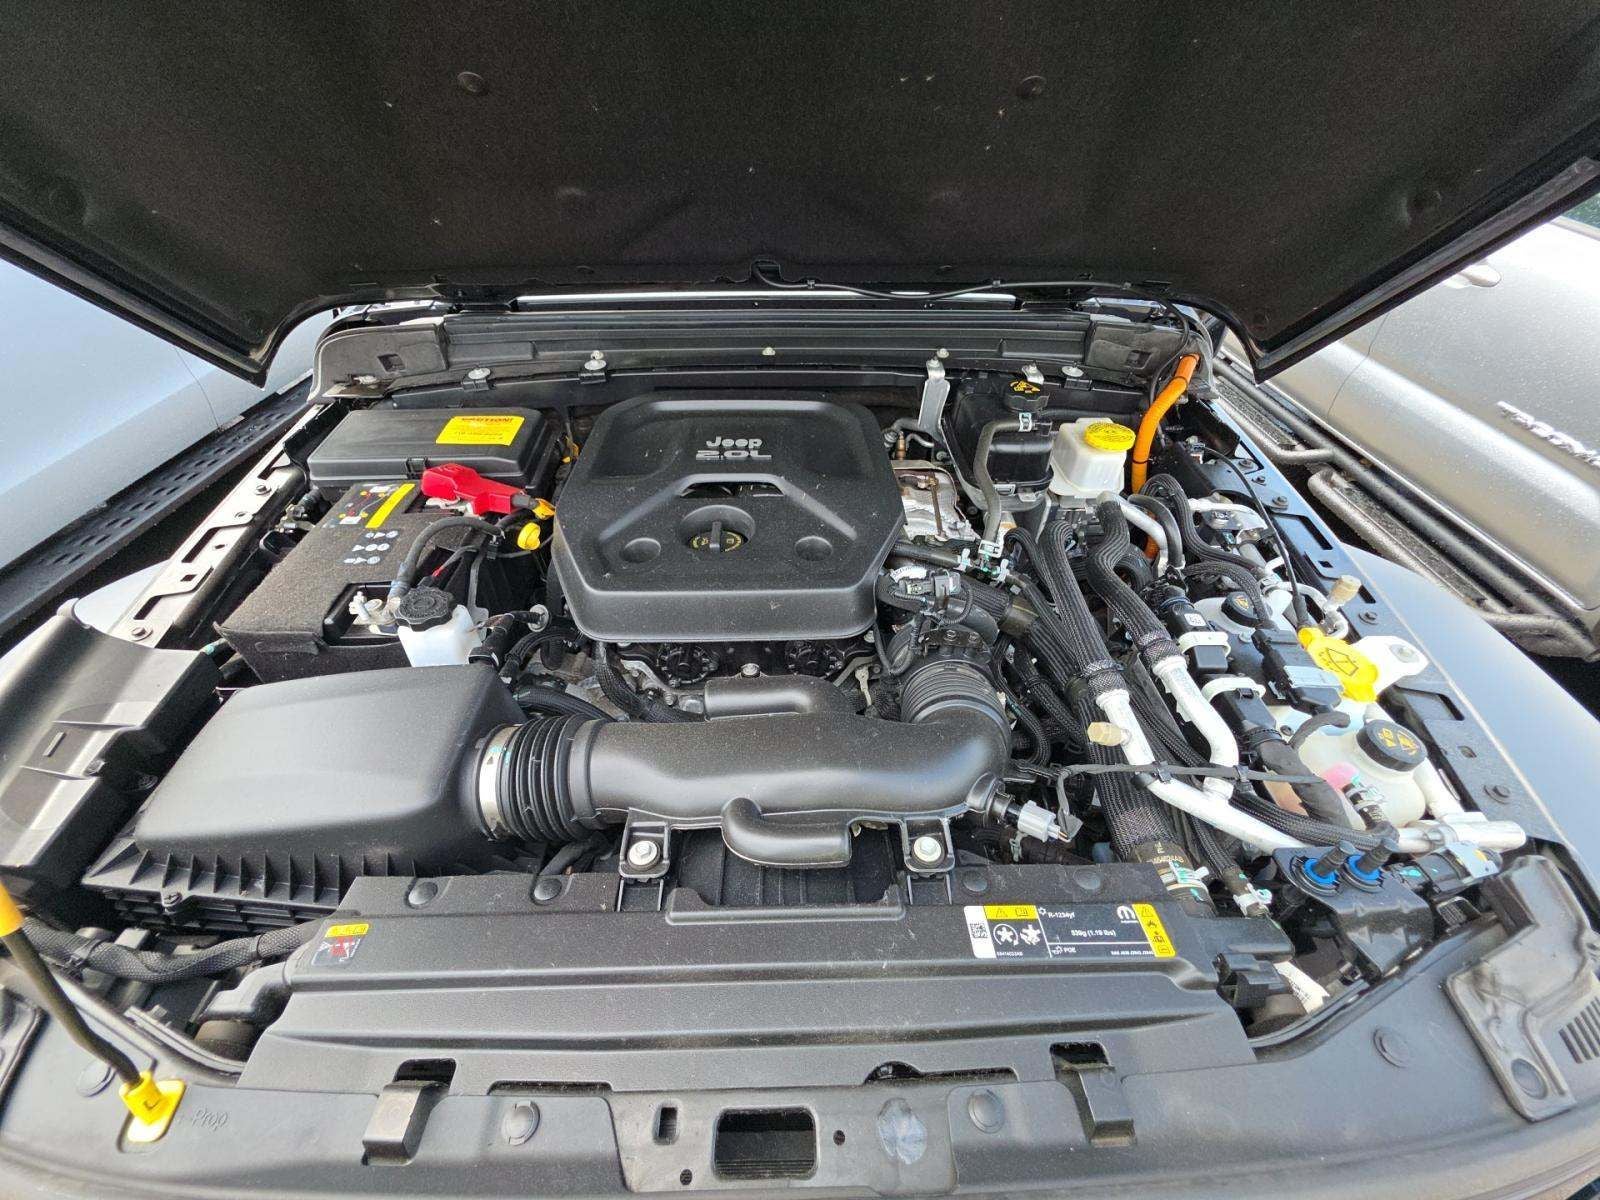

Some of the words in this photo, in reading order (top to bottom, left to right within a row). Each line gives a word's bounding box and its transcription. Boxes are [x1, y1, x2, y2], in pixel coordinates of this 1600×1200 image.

[706, 436, 763, 448] Jeep
[696, 450, 772, 461] 2.0L
[192, 1108, 229, 1131] Prop
